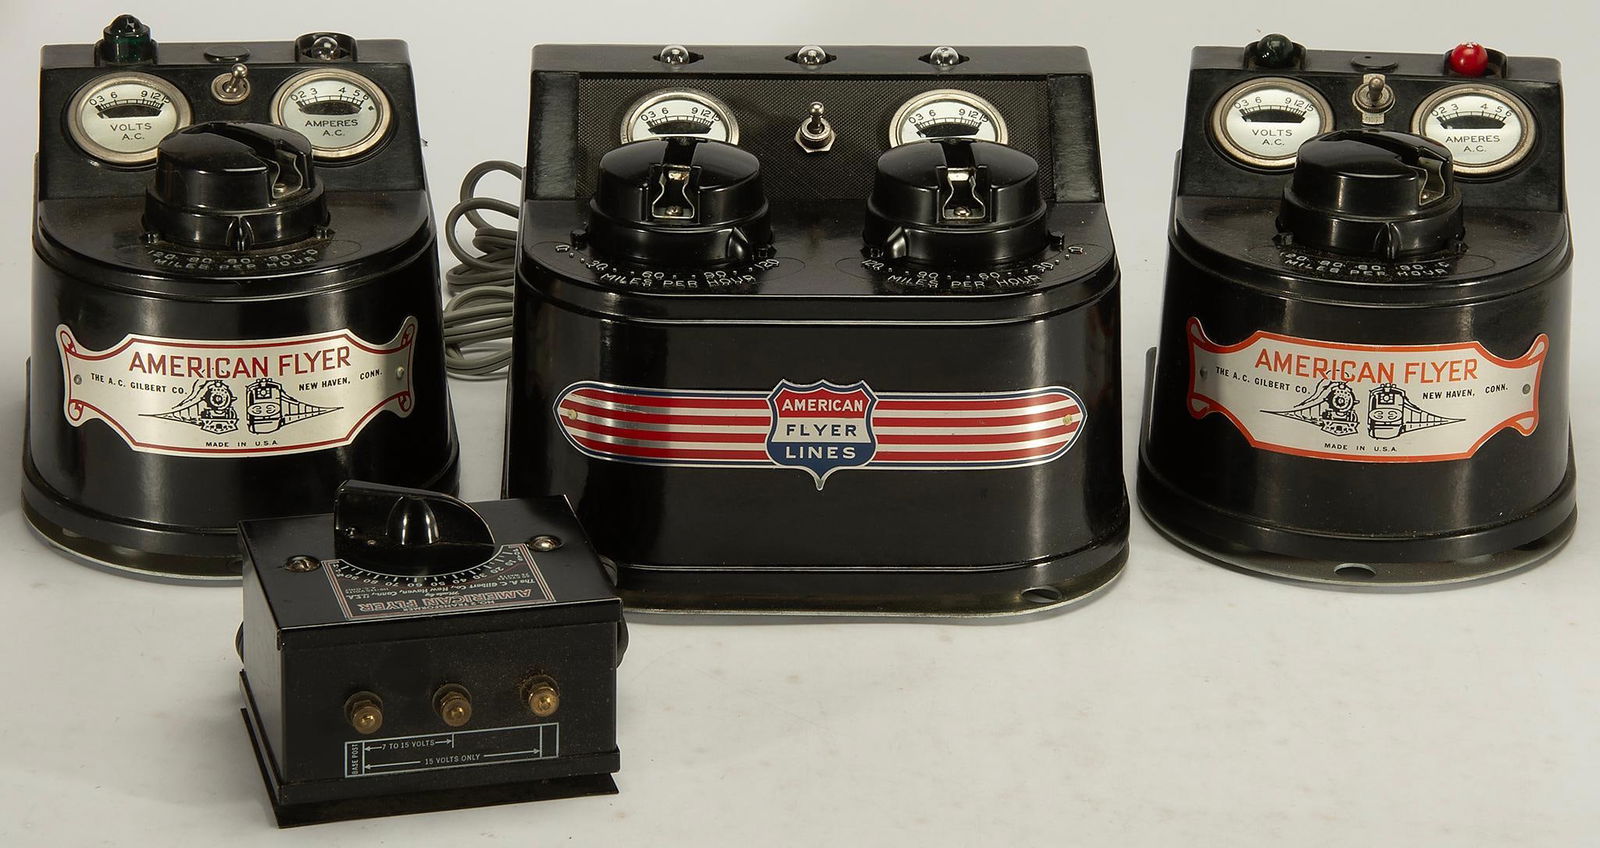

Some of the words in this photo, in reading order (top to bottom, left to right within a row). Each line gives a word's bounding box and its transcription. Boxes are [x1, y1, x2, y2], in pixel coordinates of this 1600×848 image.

[110, 91, 118, 99] 6
[141, 90, 148, 98] 9
[150, 90, 161, 99] 12
[310, 87, 318, 95] 3
[338, 86, 347, 94] 4
[353, 89, 360, 98] 5
[362, 93, 370, 101] 6
[1254, 96, 1262, 104] 6
[1284, 97, 1292, 105] 9
[1293, 99, 1305, 107] 12
[1304, 102, 1315, 112] 15
[1451, 103, 1459, 111] 3
[1480, 103, 1489, 111] 4
[1494, 105, 1503, 114] 5
[1505, 108, 1513, 117] 6
[661, 107, 669, 115] 6
[691, 107, 699, 115] 9
[700, 109, 711, 118] 12
[928, 109, 937, 117] 6
[958, 108, 966, 116] 9
[967, 109, 979, 118] 12
[110, 121, 153, 132] VOLTS
[304, 118, 359, 128] AMPERES
[121, 133, 145, 141] A.C.
[1251, 128, 1293, 137] VOLTS
[1445, 134, 1501, 143] AMPERES
[1262, 138, 1285, 146] A.C.
[1463, 145, 1487, 153] A.C.
[600, 272, 653, 287] MILES
[663, 279, 698, 288] PER
[706, 274, 757, 287] HOUR
[887, 274, 939, 289] MILES
[951, 280, 985, 288] PER
[996, 274, 1042, 287] HOUR
[127, 351, 270, 380] AMERICAN
[278, 345, 352, 377] FLYER
[1254, 348, 1395, 385] AMERICAN
[1403, 358, 1479, 384] FLYER
[90, 372, 105, 384] THE
[130, 382, 167, 394] GILBERT
[171, 386, 188, 396] CO.
[298, 381, 319, 392] NEW
[321, 376, 351, 389] HAVEN,
[359, 368, 383, 382] CONN.
[1215, 366, 1230, 379] THE
[1253, 377, 1291, 392] GILBERT
[1294, 385, 1311, 395] CO.
[1422, 390, 1442, 400] NEW
[1445, 388, 1476, 399] HAVEN,
[1484, 383, 1509, 395] CONN.
[781, 398, 864, 413] AMERICAN
[785, 422, 858, 437] FLYER
[205, 440, 230, 448] MADE
[1324, 442, 1349, 451] MADE
[785, 445, 856, 460] LINES
[451, 577, 468, 585] 40
[468, 581, 499, 589] Gilbert
[421, 588, 533, 606] AMERICAN
[358, 599, 418, 613] FLYER
[400, 741, 410, 749] 15
[411, 739, 435, 748] VOLTS
[351, 743, 359, 758] POST
[435, 755, 460, 764] VOLTS
[461, 753, 481, 762] ONLY
[351, 759, 359, 775] BASE
